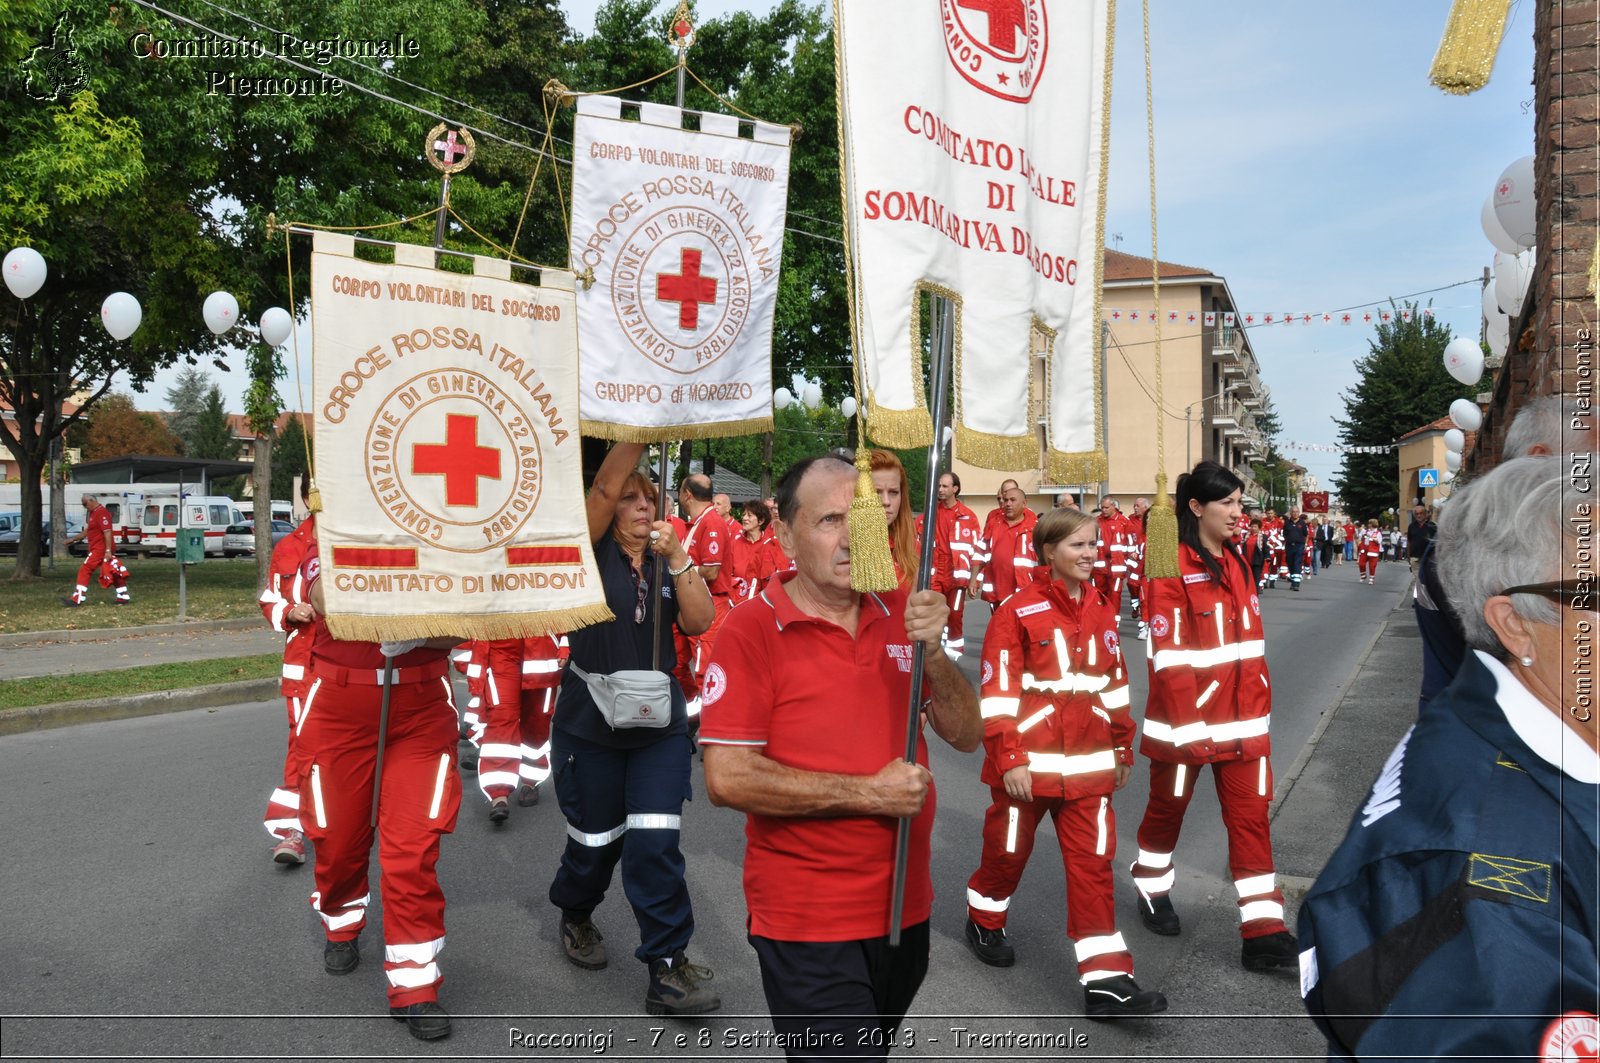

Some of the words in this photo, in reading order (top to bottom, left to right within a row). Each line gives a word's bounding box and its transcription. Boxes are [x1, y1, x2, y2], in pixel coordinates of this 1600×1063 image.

[904, 105, 1013, 171] COMITATO
[590, 141, 632, 161] CORPO
[639, 148, 699, 170] VOLONTARI
[706, 158, 726, 174] DEL
[731, 161, 775, 182] SOCCORSO
[987, 181, 1016, 211] DI
[581, 191, 643, 268] CROCE
[643, 175, 715, 203] ROSSA
[720, 187, 773, 283] ITALIANA
[644, 221, 663, 241] DI
[668, 212, 730, 247] GINEVRA
[864, 190, 1007, 253] SOMMARIVA
[726, 249, 742, 270] 22
[332, 275, 381, 299] CORPO
[388, 283, 465, 307] VOLONTARI
[472, 294, 495, 312] DEL
[502, 299, 561, 322] SOCCORSO
[618, 243, 675, 363] CONVENZIONE
[723, 276, 747, 337] AGOSTO
[695, 335, 727, 364] 1864
[323, 346, 392, 424] CROCE
[392, 326, 483, 357] ROSSA
[489, 343, 569, 446] ITALIANA
[400, 387, 422, 410] DI
[427, 374, 506, 415] GINEVRA
[595, 381, 662, 403] GRUPPO
[671, 386, 683, 403] di
[689, 382, 753, 402] MOROZZO
[508, 416, 529, 440] 22
[368, 410, 443, 541] CONVENZIONE
[511, 445, 537, 513] AGOSTO
[482, 510, 518, 542] 1864
[335, 573, 453, 593] COMITATO
[462, 575, 484, 594] DI
